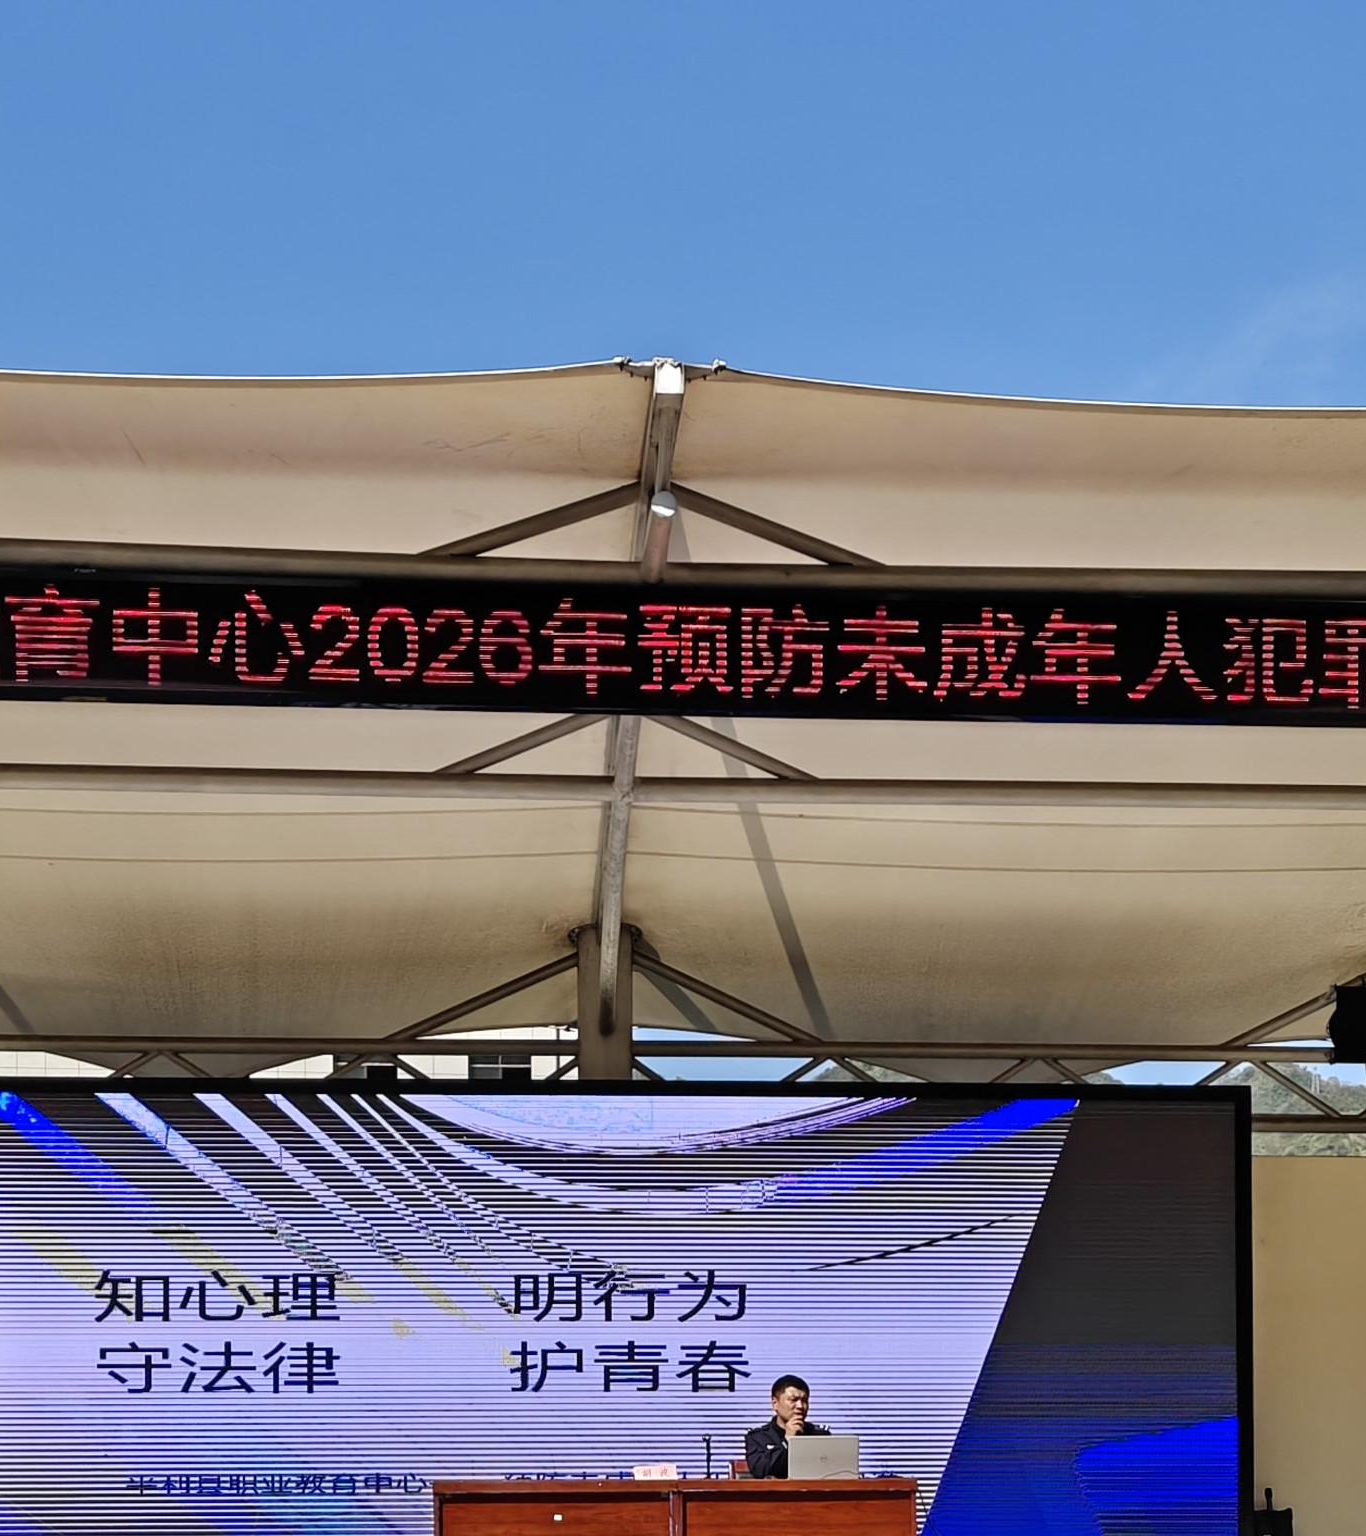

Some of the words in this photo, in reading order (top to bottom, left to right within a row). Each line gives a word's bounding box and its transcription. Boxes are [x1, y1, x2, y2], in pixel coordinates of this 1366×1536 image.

[94, 1269, 341, 1323] 知心理
[513, 1269, 748, 1323] 明行为
[96, 1341, 341, 1394] 守法律
[509, 1340, 752, 1393] 护青春
